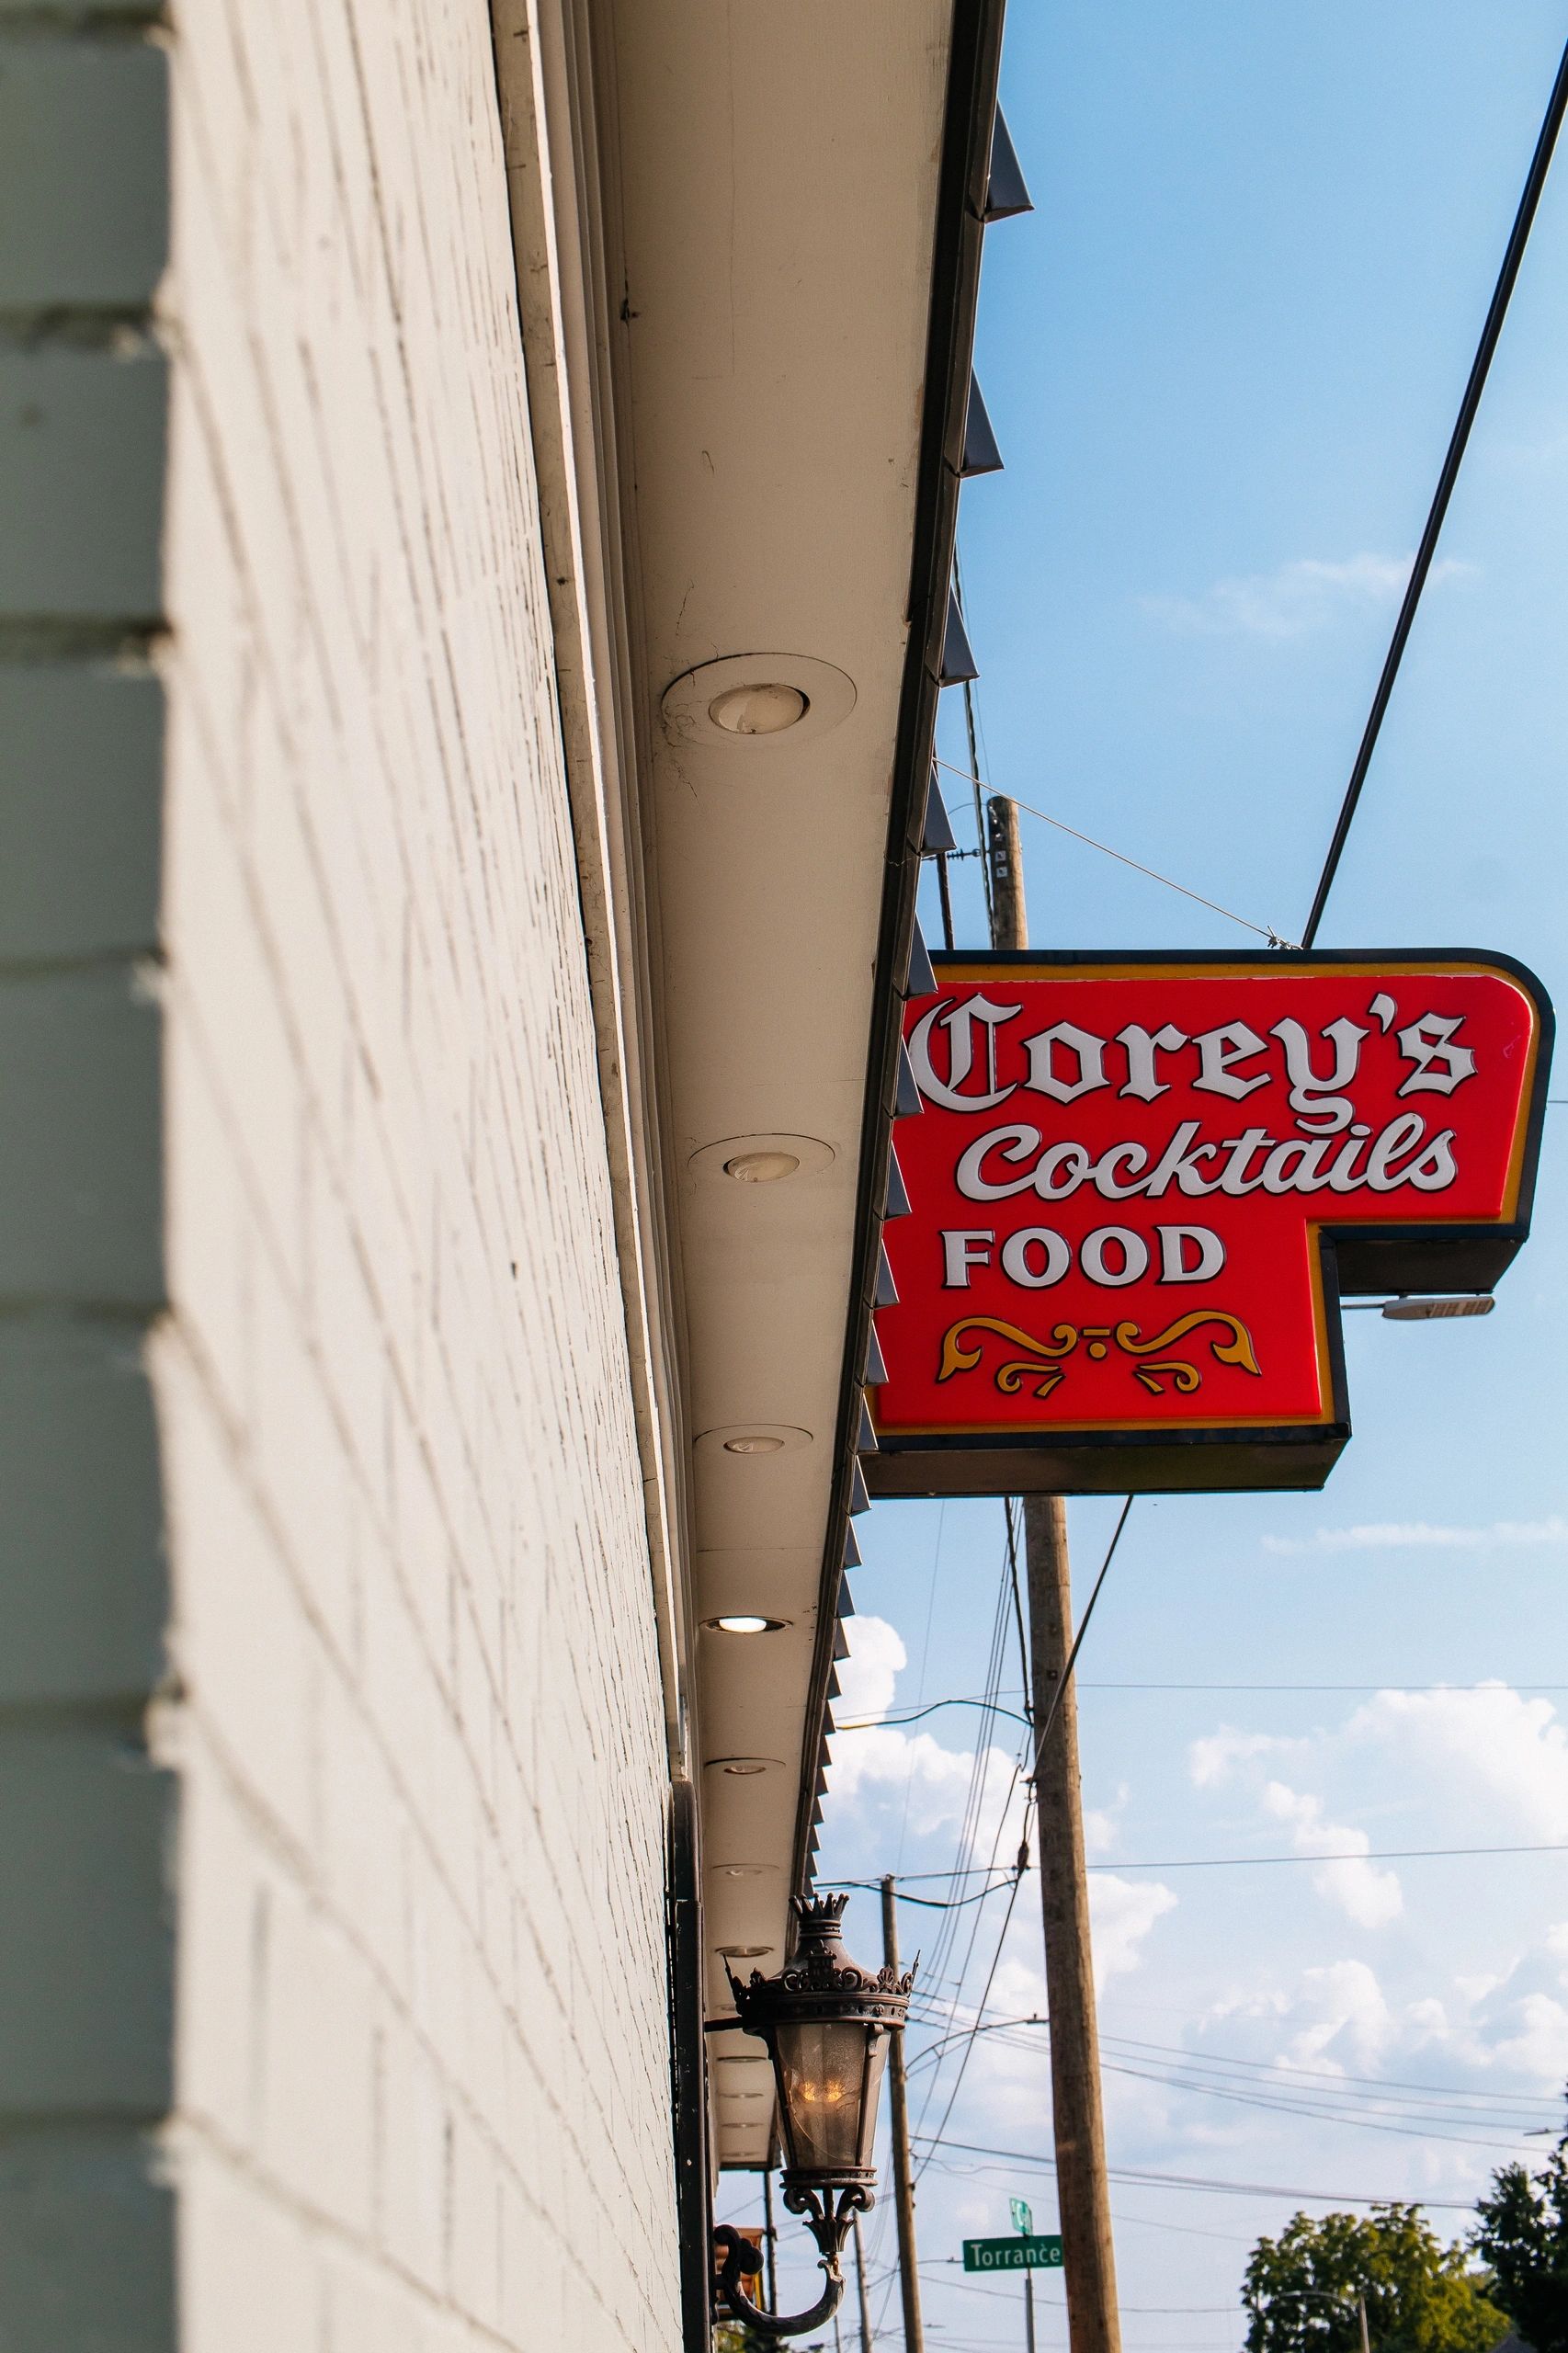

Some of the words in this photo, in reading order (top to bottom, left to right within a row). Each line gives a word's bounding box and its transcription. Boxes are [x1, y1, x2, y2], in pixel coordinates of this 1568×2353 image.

[908, 993, 1478, 1134] Corey's
[955, 1112, 1458, 1201] Cocktails
[940, 1225, 1226, 1288] FOOD
[971, 2244, 1061, 2267] Torrance
